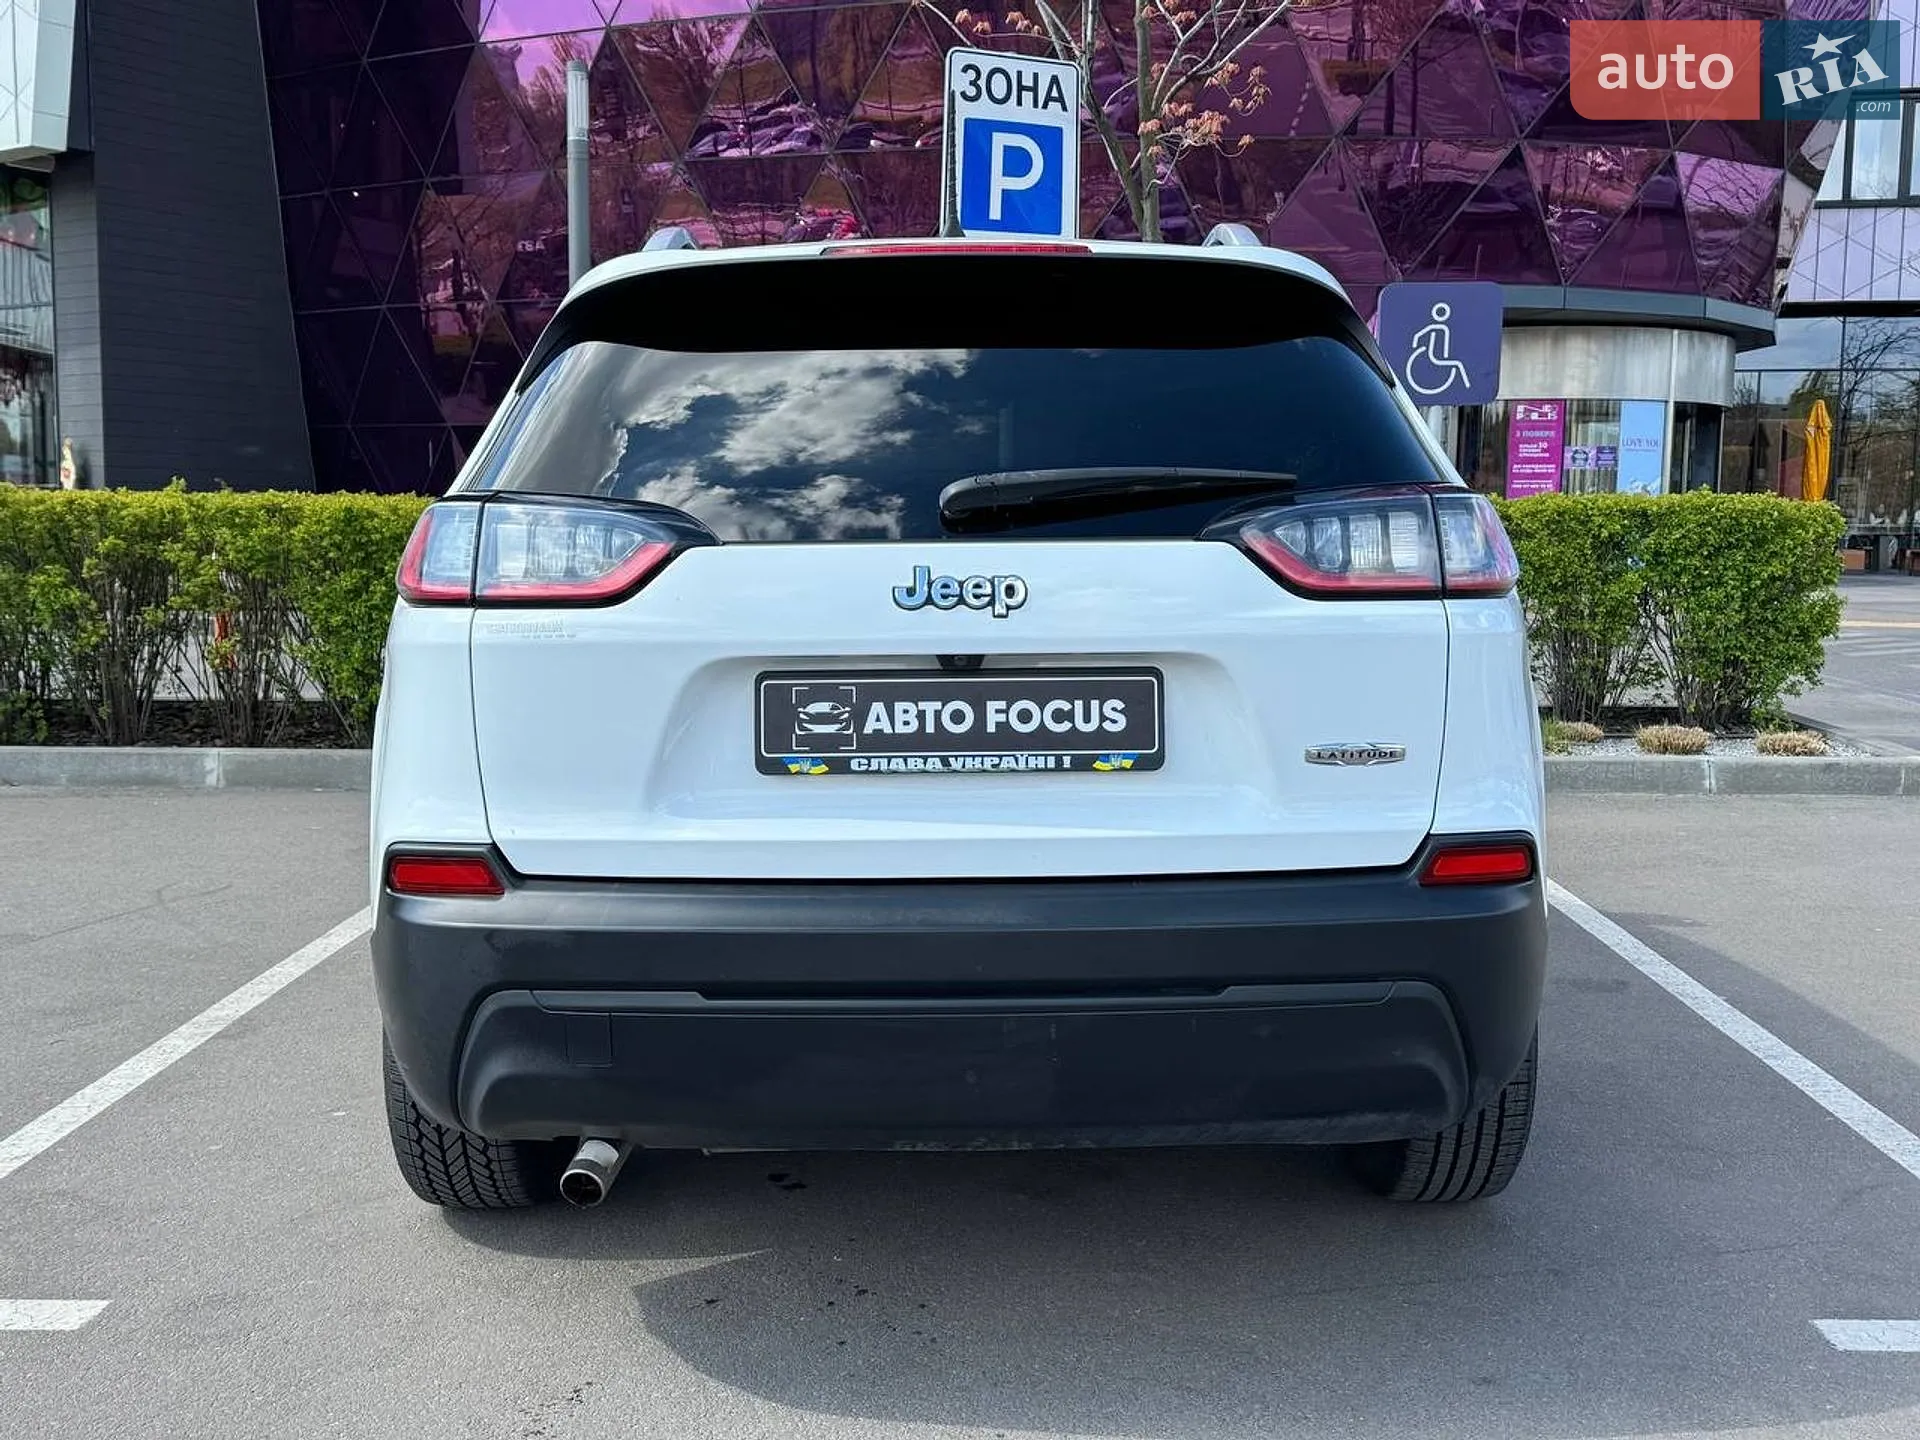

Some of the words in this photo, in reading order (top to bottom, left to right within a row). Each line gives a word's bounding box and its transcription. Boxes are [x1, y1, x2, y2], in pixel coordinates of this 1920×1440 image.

[960, 63, 1069, 113] ЗОНА
[989, 131, 1044, 221] P
[893, 565, 1028, 618] Jeep
[986, 699, 1128, 734] FOCUS
[850, 756, 942, 772] СЛАВА
